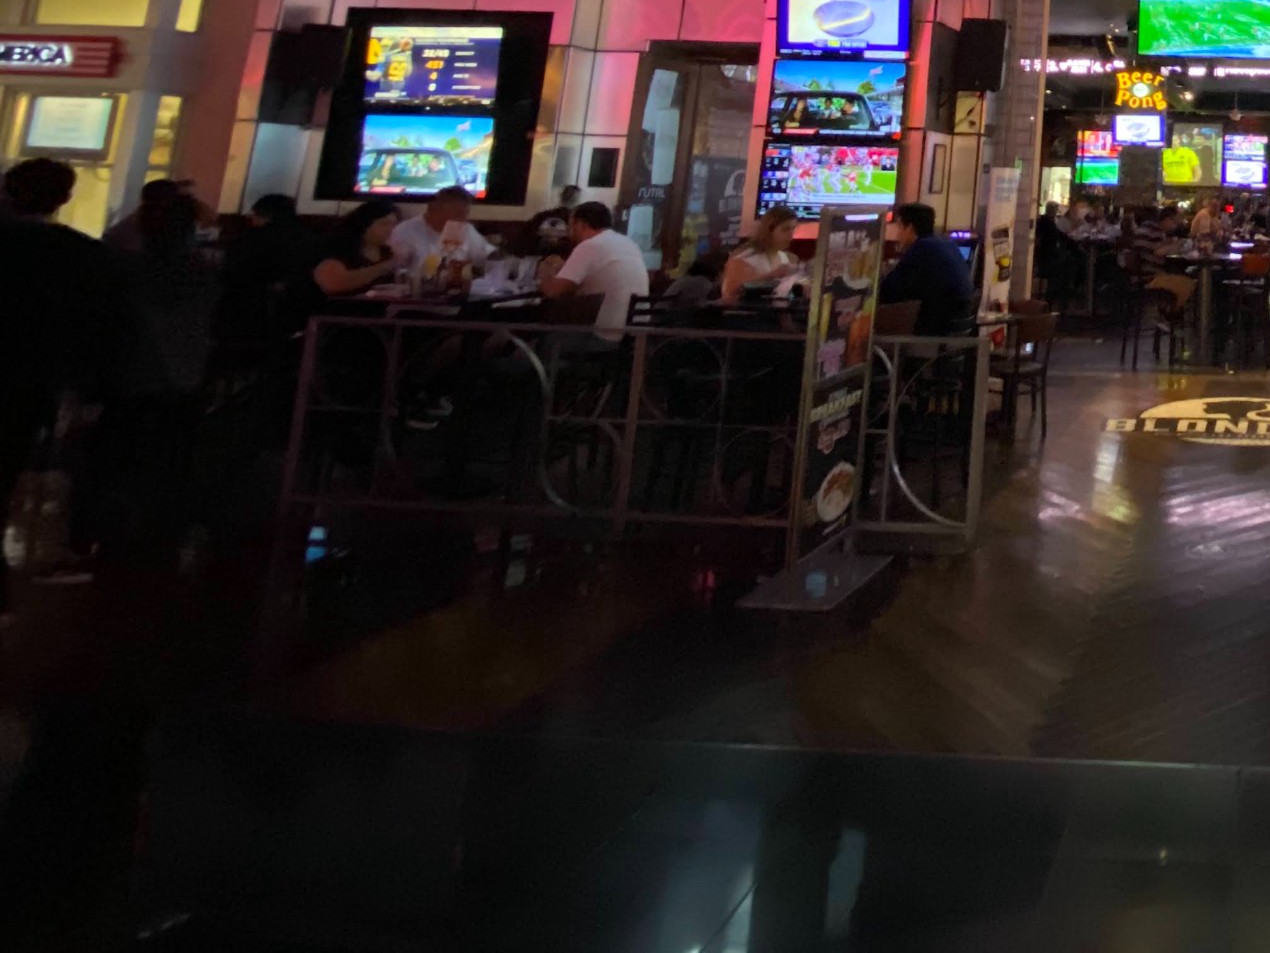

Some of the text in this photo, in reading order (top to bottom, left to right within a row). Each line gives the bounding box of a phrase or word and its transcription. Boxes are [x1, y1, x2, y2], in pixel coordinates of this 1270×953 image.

[1115, 71, 1165, 89] Beer
[1114, 90, 1167, 111] Pong
[950, 231, 972, 239] ATM
